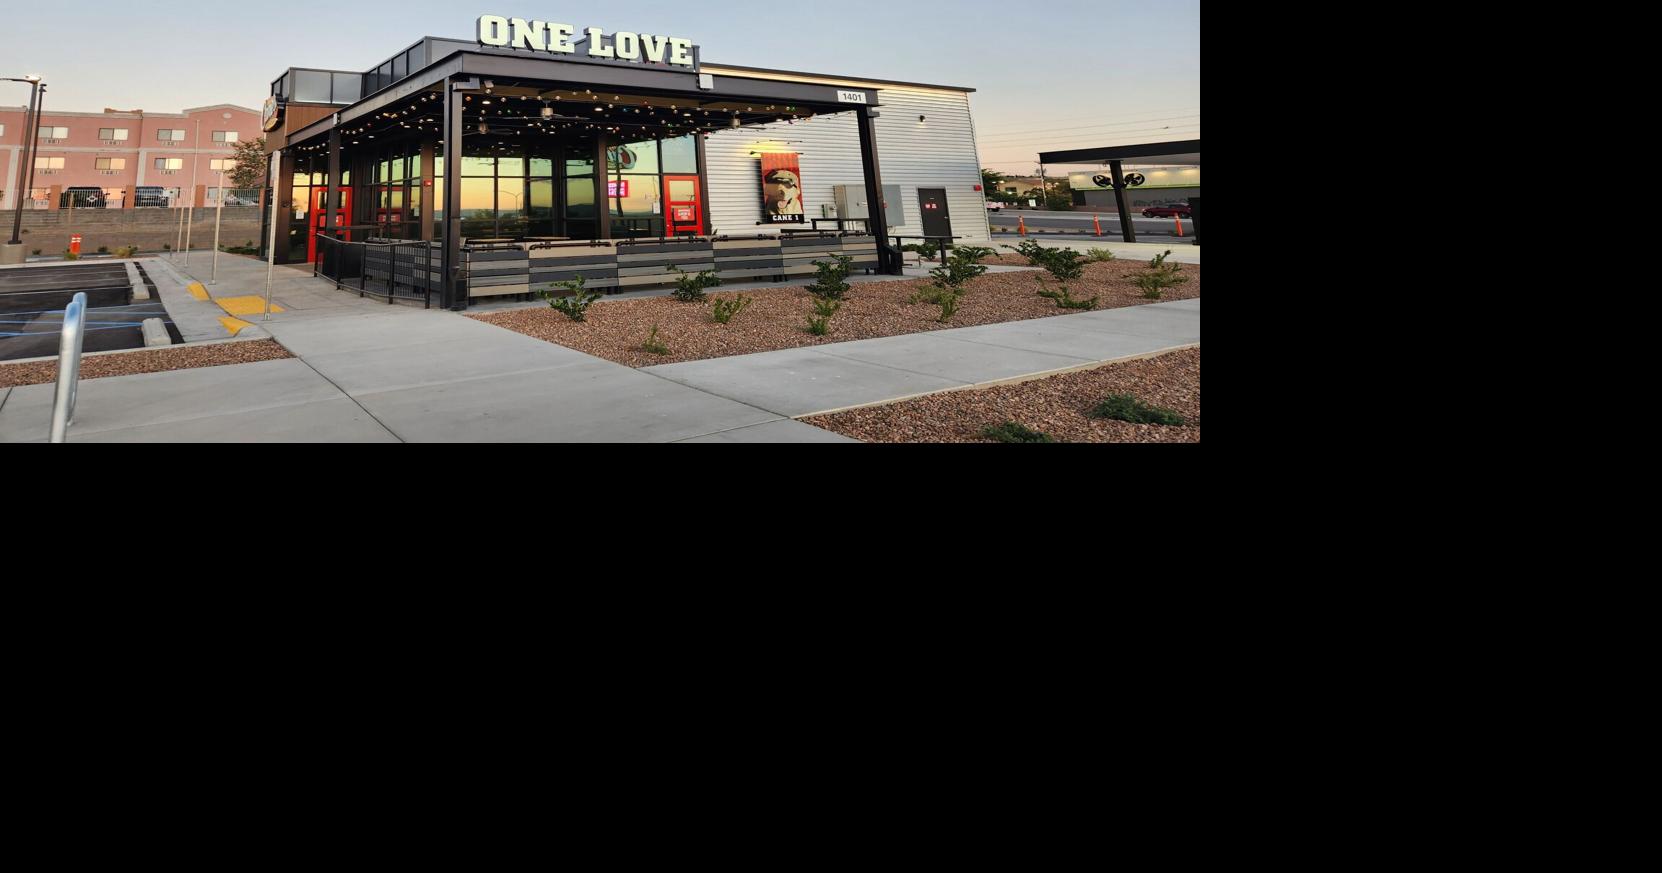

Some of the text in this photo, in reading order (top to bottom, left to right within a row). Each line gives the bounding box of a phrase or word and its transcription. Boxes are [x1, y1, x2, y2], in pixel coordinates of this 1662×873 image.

[478, 14, 694, 65] ONE LOVE
[842, 93, 862, 102] 1401
